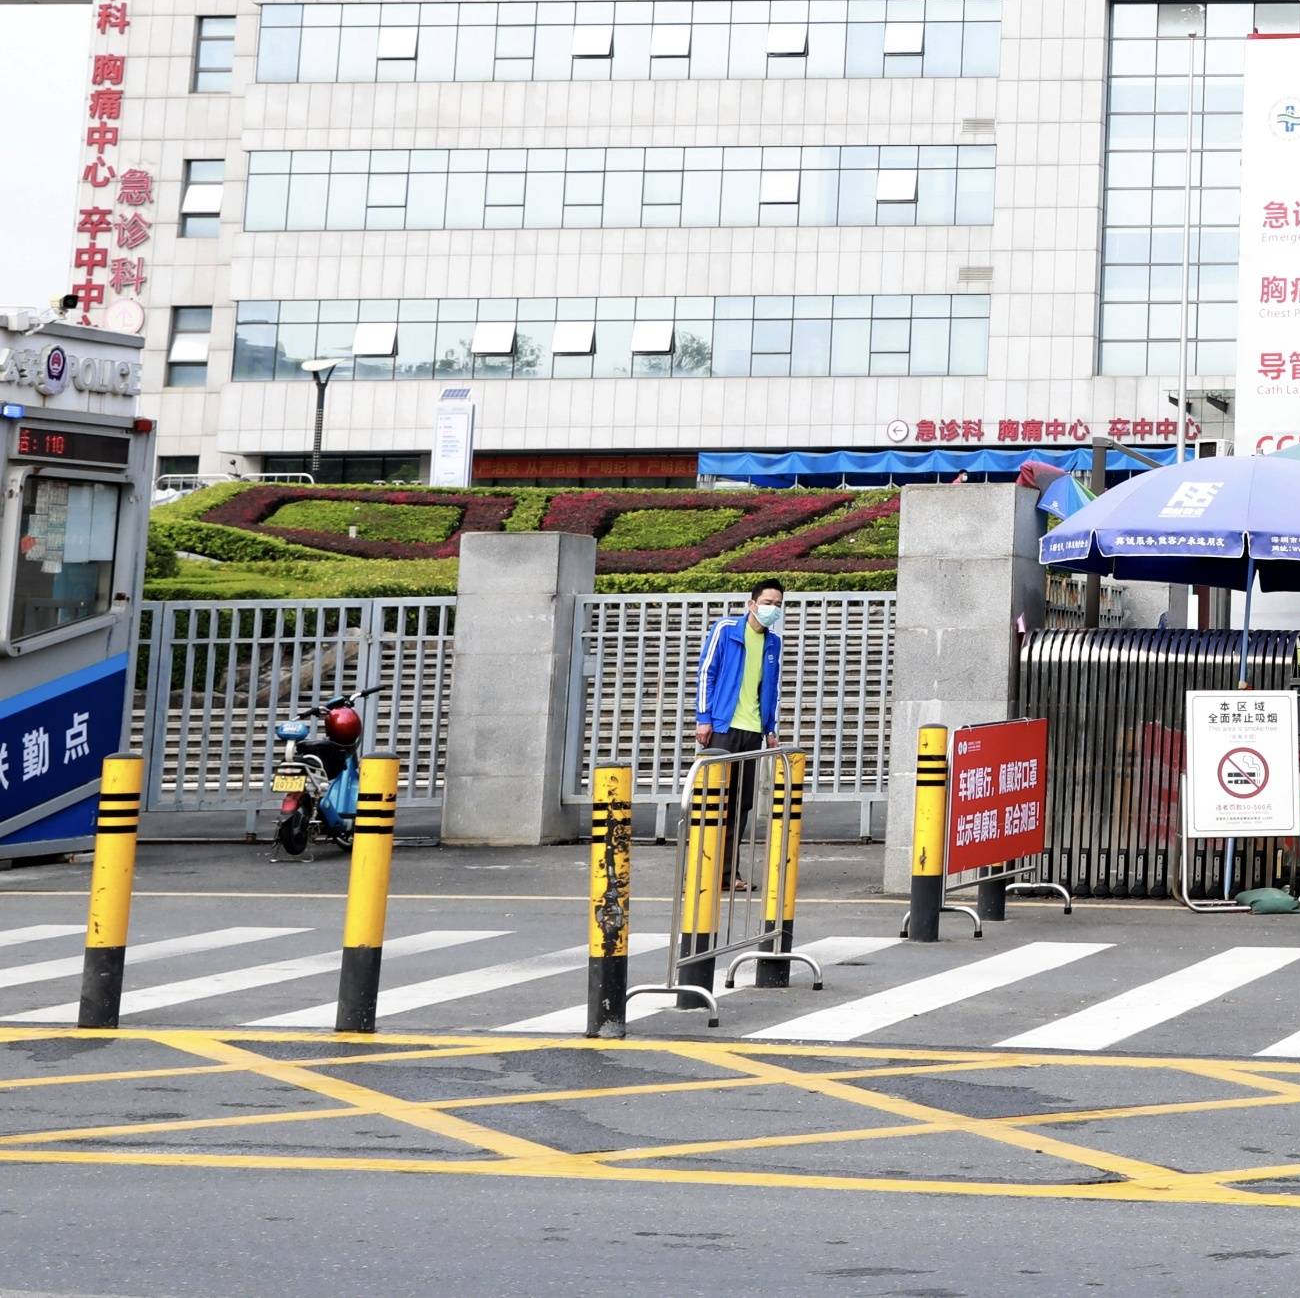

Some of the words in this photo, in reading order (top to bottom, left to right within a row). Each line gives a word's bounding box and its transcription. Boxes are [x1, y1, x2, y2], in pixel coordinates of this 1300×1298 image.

[83, 53, 127, 189] 胸痛中心
[108, 168, 154, 295] 急诊科
[71, 205, 113, 329] 卒中中
[1258, 308, 1291, 319] Chest
[1256, 385, 1283, 396] Cath
[915, 418, 985, 443] 急诊科
[997, 419, 1091, 442] 胸痛中心
[1208, 713, 1278, 723] 全面禁止吸烟
